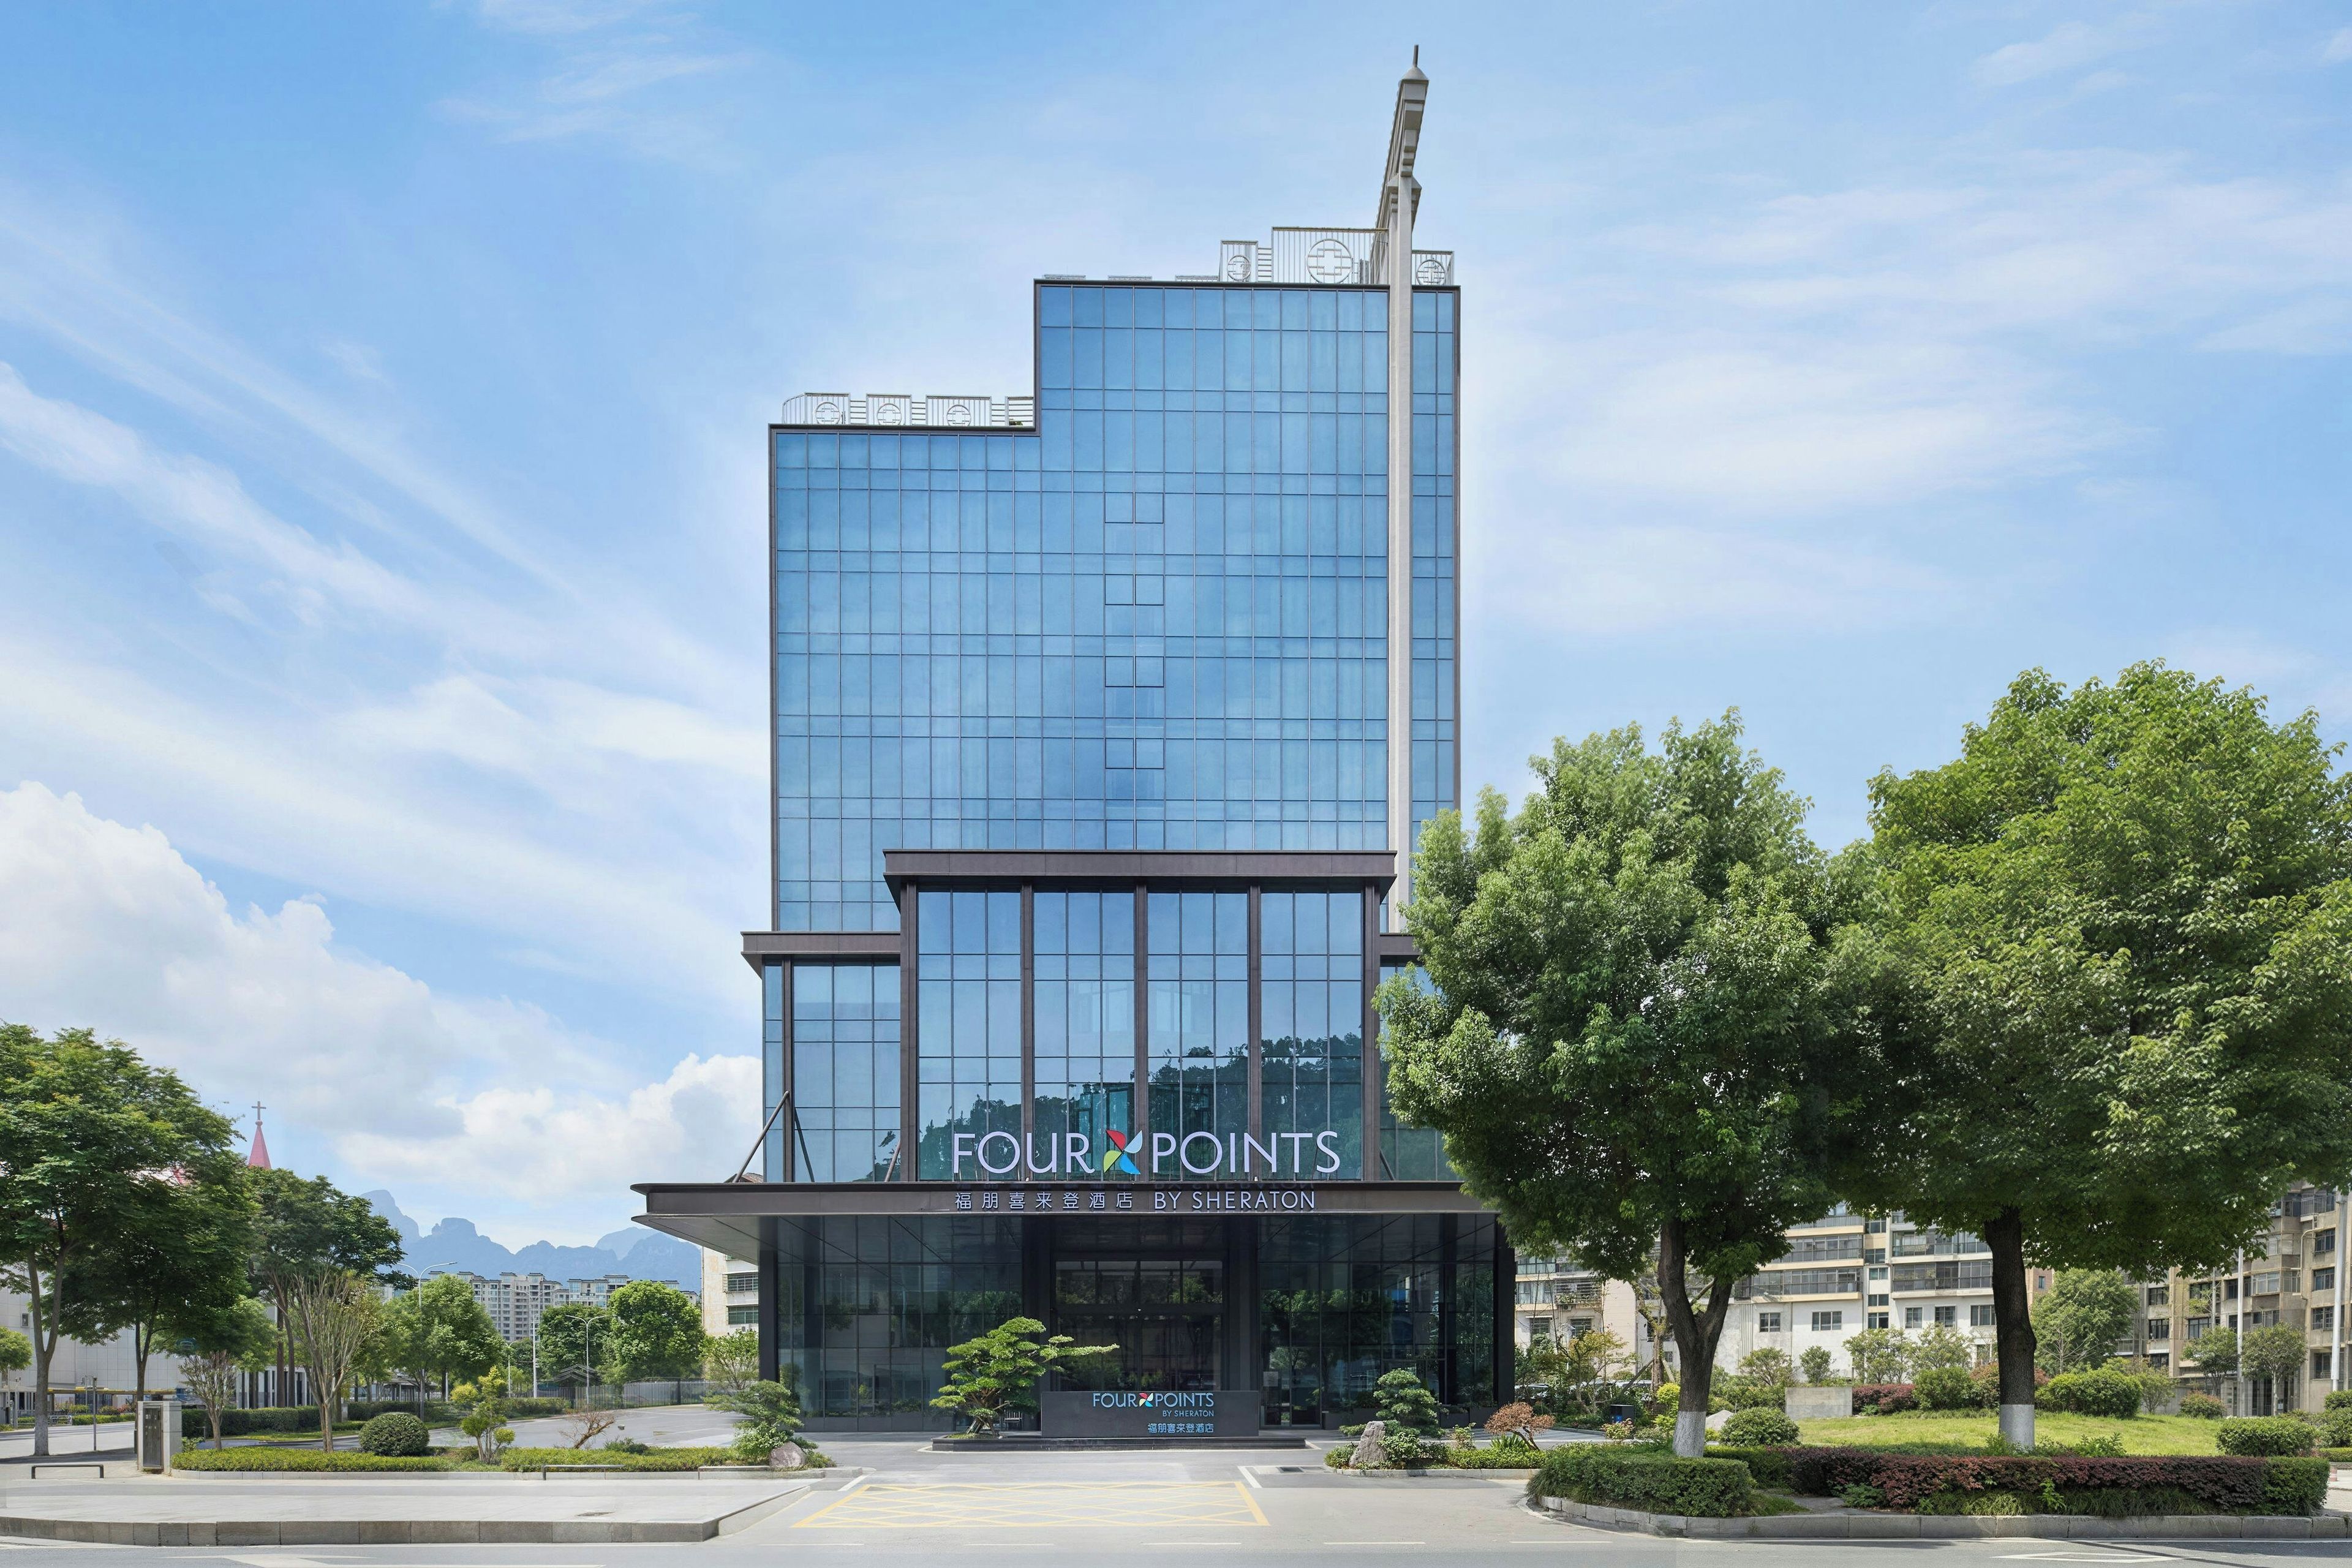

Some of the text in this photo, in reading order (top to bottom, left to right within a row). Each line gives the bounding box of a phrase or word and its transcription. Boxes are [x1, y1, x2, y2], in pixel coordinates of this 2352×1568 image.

[953, 1131, 1340, 1174] FOUR POINTS
[955, 1192, 1133, 1210] 福朋喜来登酒店
[1155, 1191, 1315, 1210] BY SHERATON
[1093, 1392, 1214, 1408] FOUR POINTS
[1147, 1423, 1214, 1433] 福朋喜来登酒店
